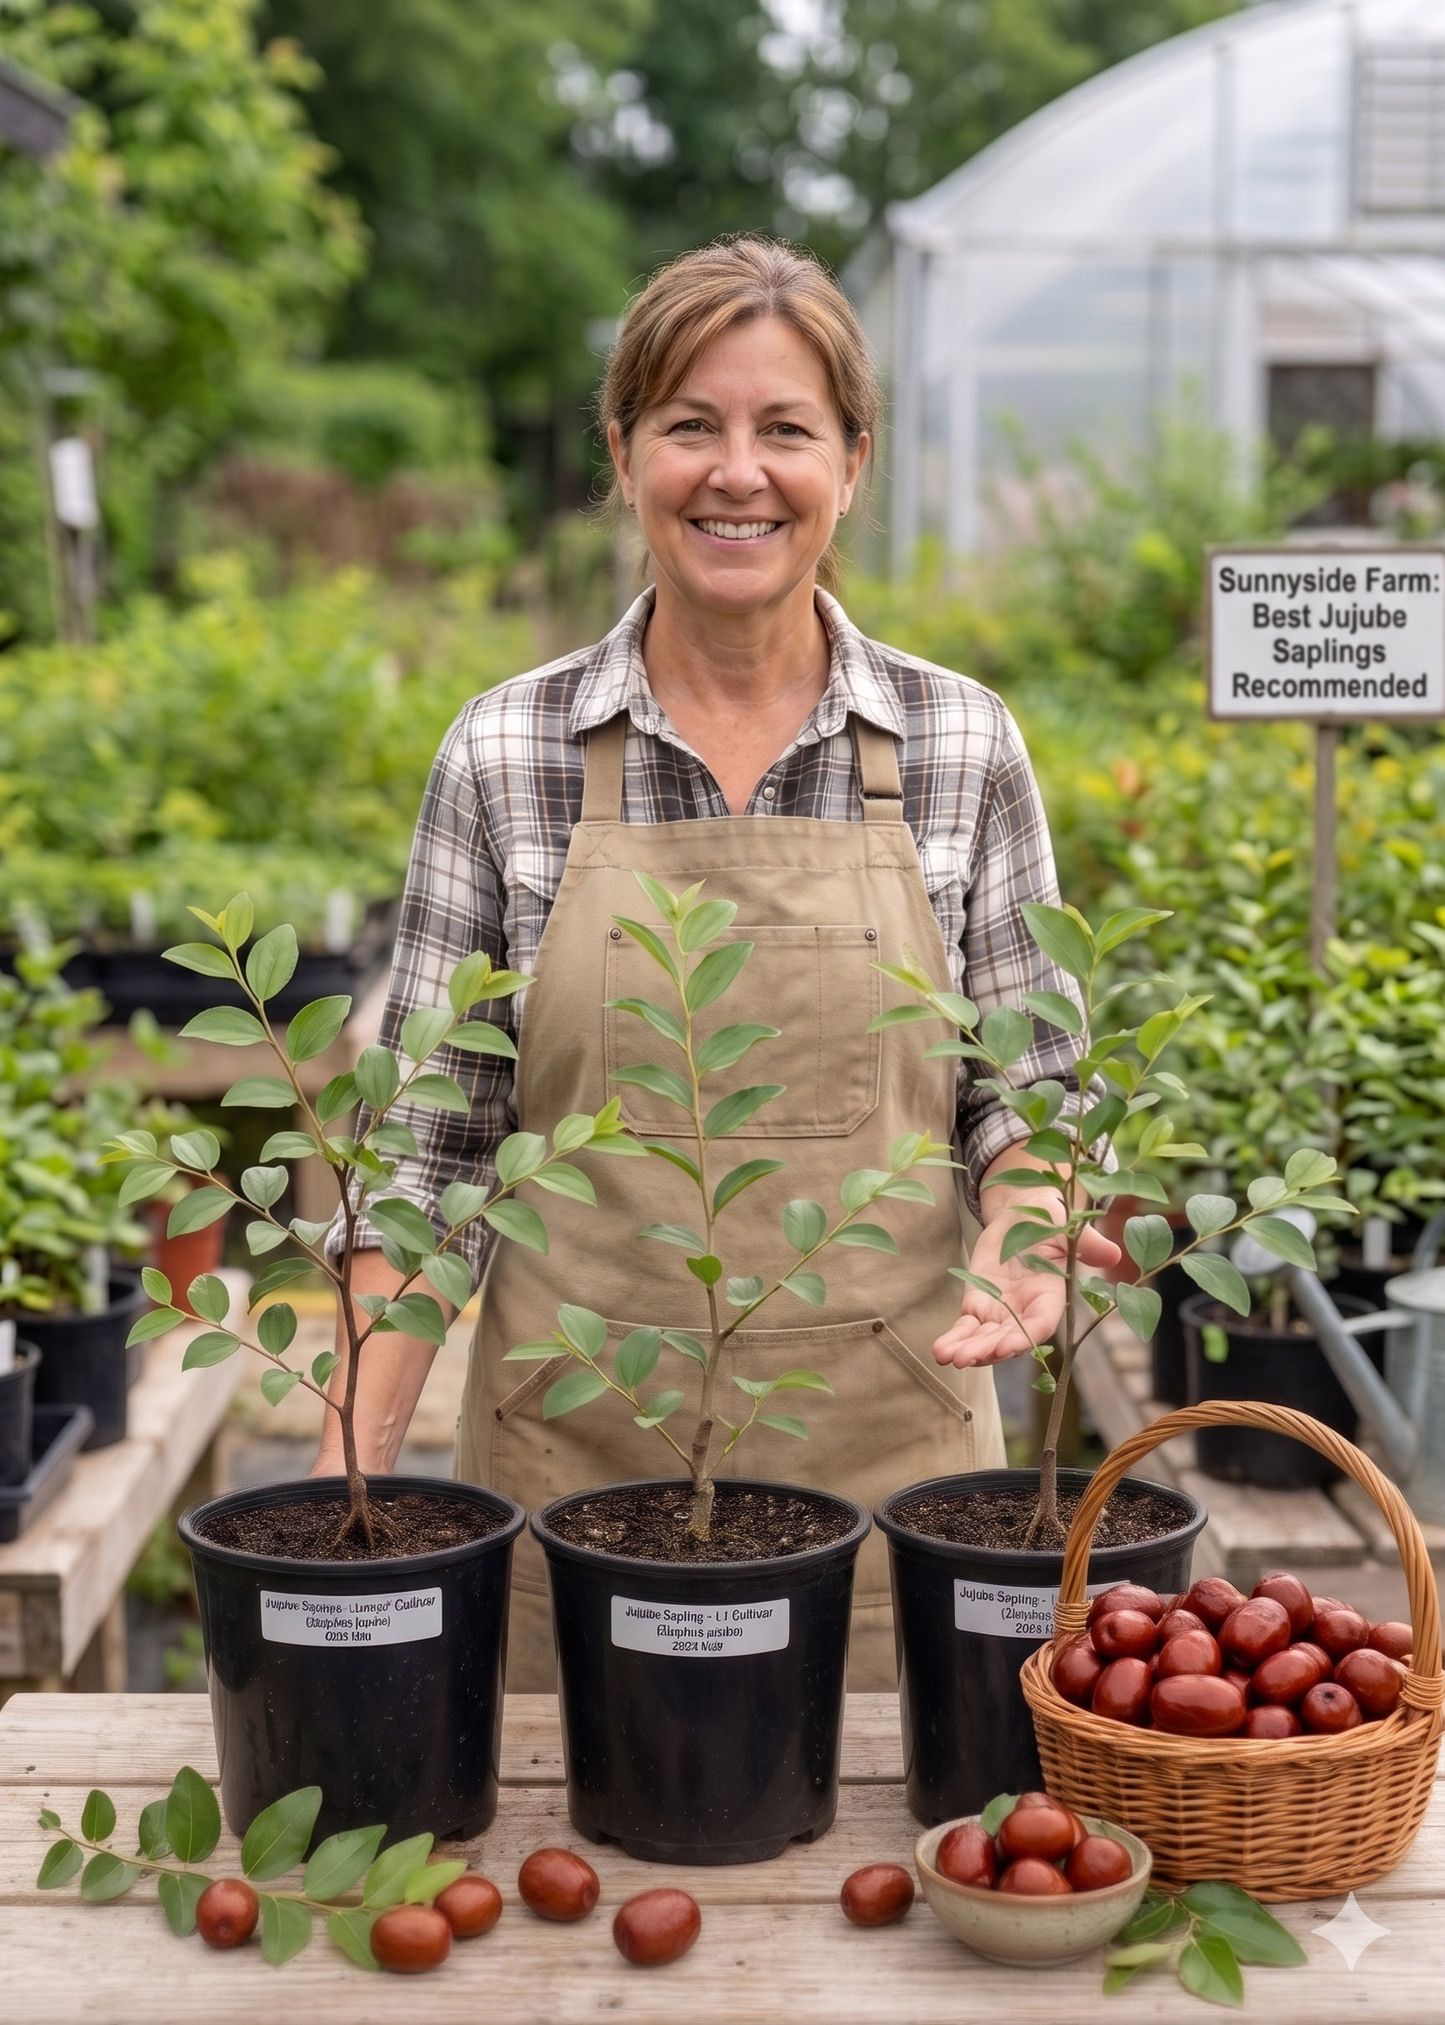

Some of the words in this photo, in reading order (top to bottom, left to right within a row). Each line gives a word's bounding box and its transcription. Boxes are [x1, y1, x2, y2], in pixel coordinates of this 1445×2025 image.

[1219, 567, 1357, 599] Sunnyside
[1366, 567, 1440, 593] Farm:
[1253, 603, 1312, 629] Best
[1319, 603, 1408, 635] Jujube
[1273, 638, 1387, 670] Saplings
[1232, 672, 1428, 698] Recommended
[663, 1609, 704, 1625] Sapling
[732, 1609, 774, 1621] Cultivar
